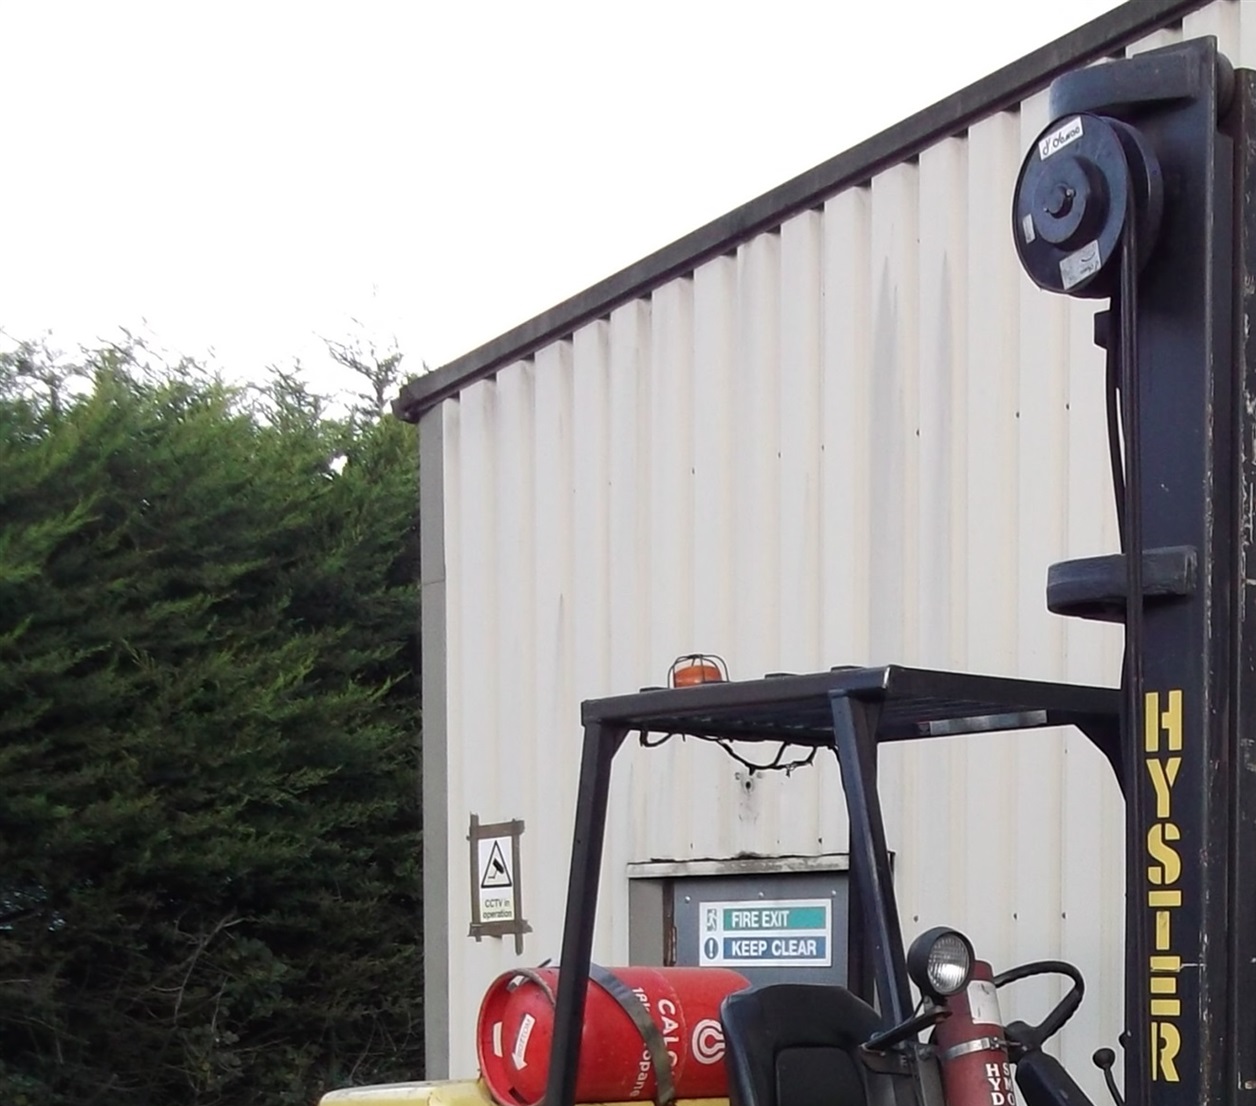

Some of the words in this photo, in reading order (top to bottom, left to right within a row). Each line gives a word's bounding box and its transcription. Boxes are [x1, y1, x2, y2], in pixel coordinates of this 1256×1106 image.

[1144, 689, 1183, 1082] HYSTER
[484, 899, 502, 908] CCTV
[482, 909, 512, 919] operation
[731, 910, 759, 928] FIRE
[762, 910, 790, 927] EXIT
[731, 940, 767, 956] KEEP
[771, 939, 817, 956] CLEAR
